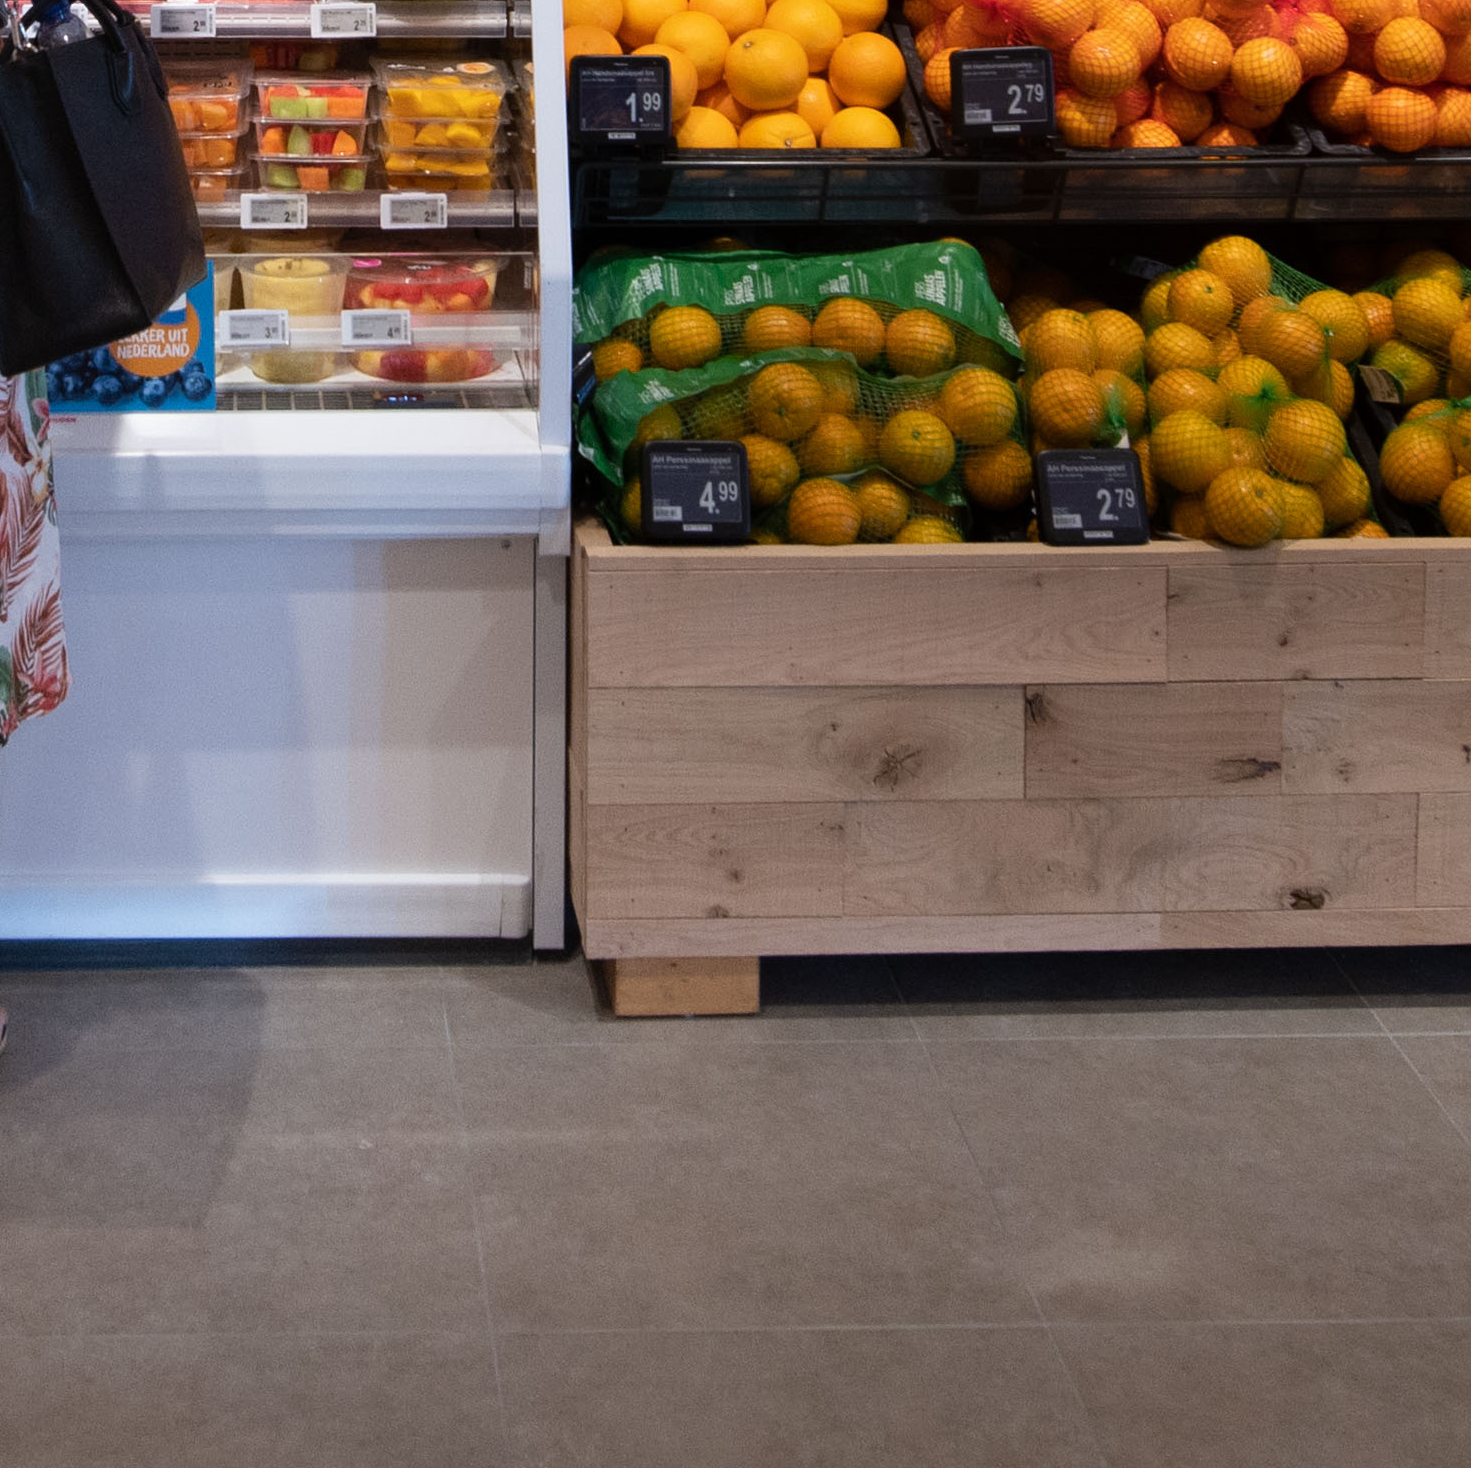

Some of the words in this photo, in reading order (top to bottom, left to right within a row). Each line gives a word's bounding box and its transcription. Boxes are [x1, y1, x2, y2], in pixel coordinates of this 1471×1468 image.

[626, 92, 661, 122] 1.99
[1007, 83, 1045, 115] 2.79
[116, 343, 190, 359] NEDERLAND
[118, 328, 166, 343] KKER
[167, 328, 188, 343] UIT
[699, 480, 738, 514] 4.99
[1096, 488, 1136, 521] 2.79
